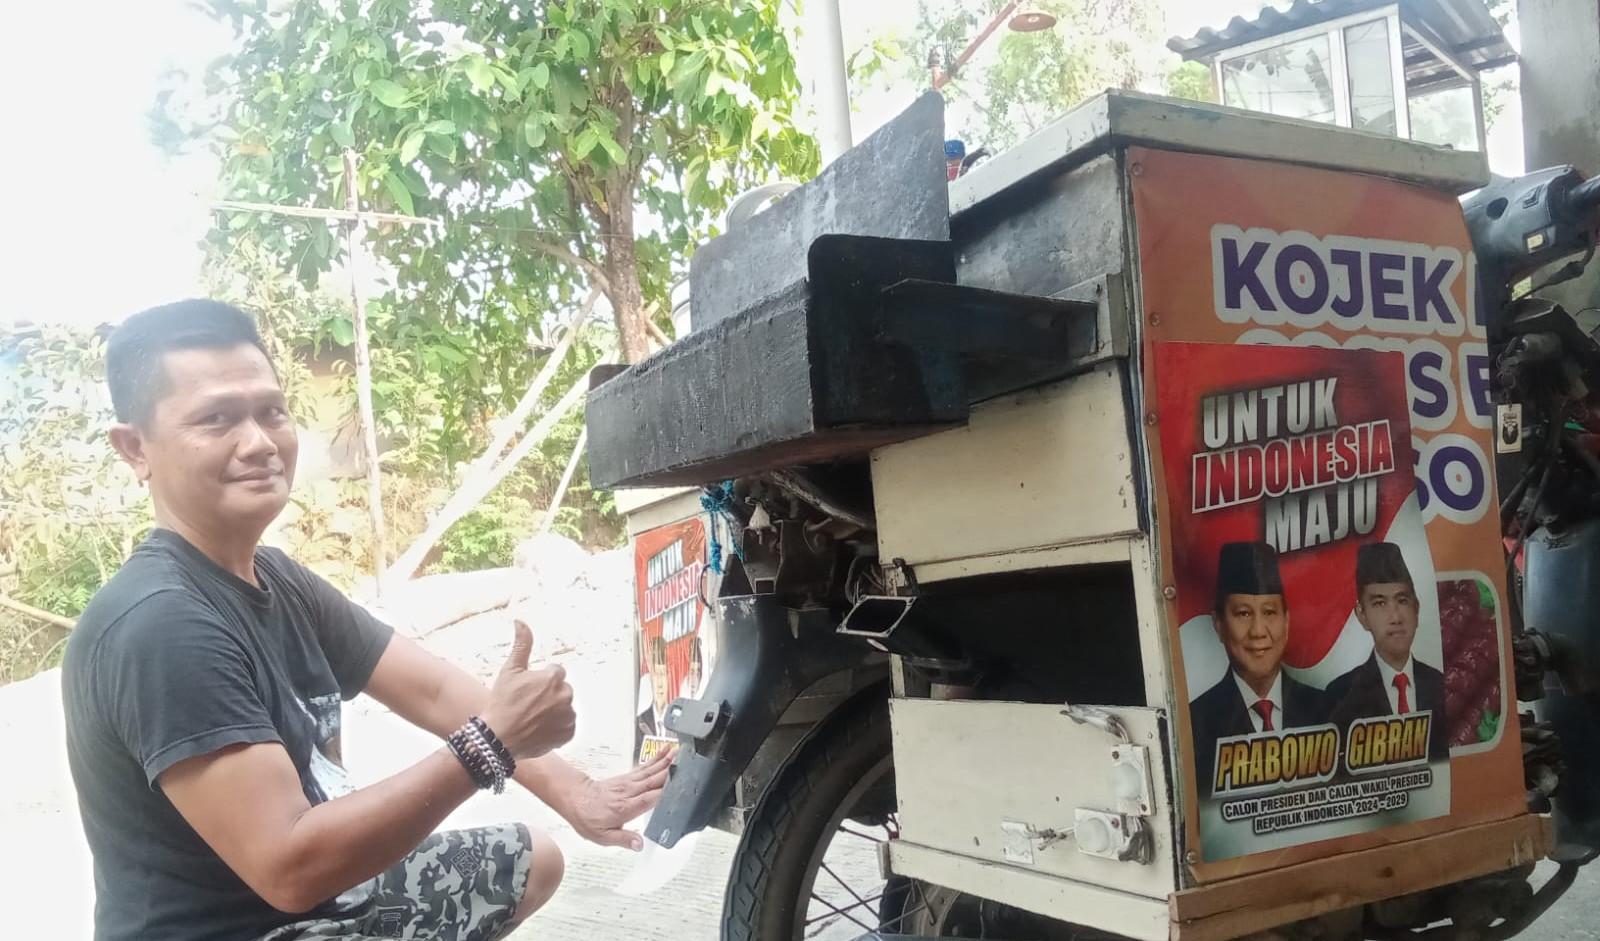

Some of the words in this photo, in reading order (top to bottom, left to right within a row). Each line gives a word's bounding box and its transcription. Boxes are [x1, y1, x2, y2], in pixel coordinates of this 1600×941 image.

[1219, 237, 1457, 324] KOJEK
[1202, 377, 1338, 449] UNTUK
[1192, 420, 1395, 513] INDONESIA
[1265, 479, 1379, 553] MAJU
[1215, 729, 1339, 791] PRABOWO
[1348, 713, 1430, 771] GIBRAN
[1224, 801, 1258, 818] CALON
[1260, 793, 1306, 813] PRESIDEN
[1308, 788, 1327, 804] DAN
[1328, 784, 1359, 800] CALON
[1361, 778, 1389, 795] WAKIL
[1390, 772, 1430, 788] PRESIDEN
[1255, 811, 1303, 831] REPUBLIK
[1303, 803, 1354, 822] INDONESIA
[1355, 798, 1379, 814] 2024
[1385, 793, 1407, 808] 2029
